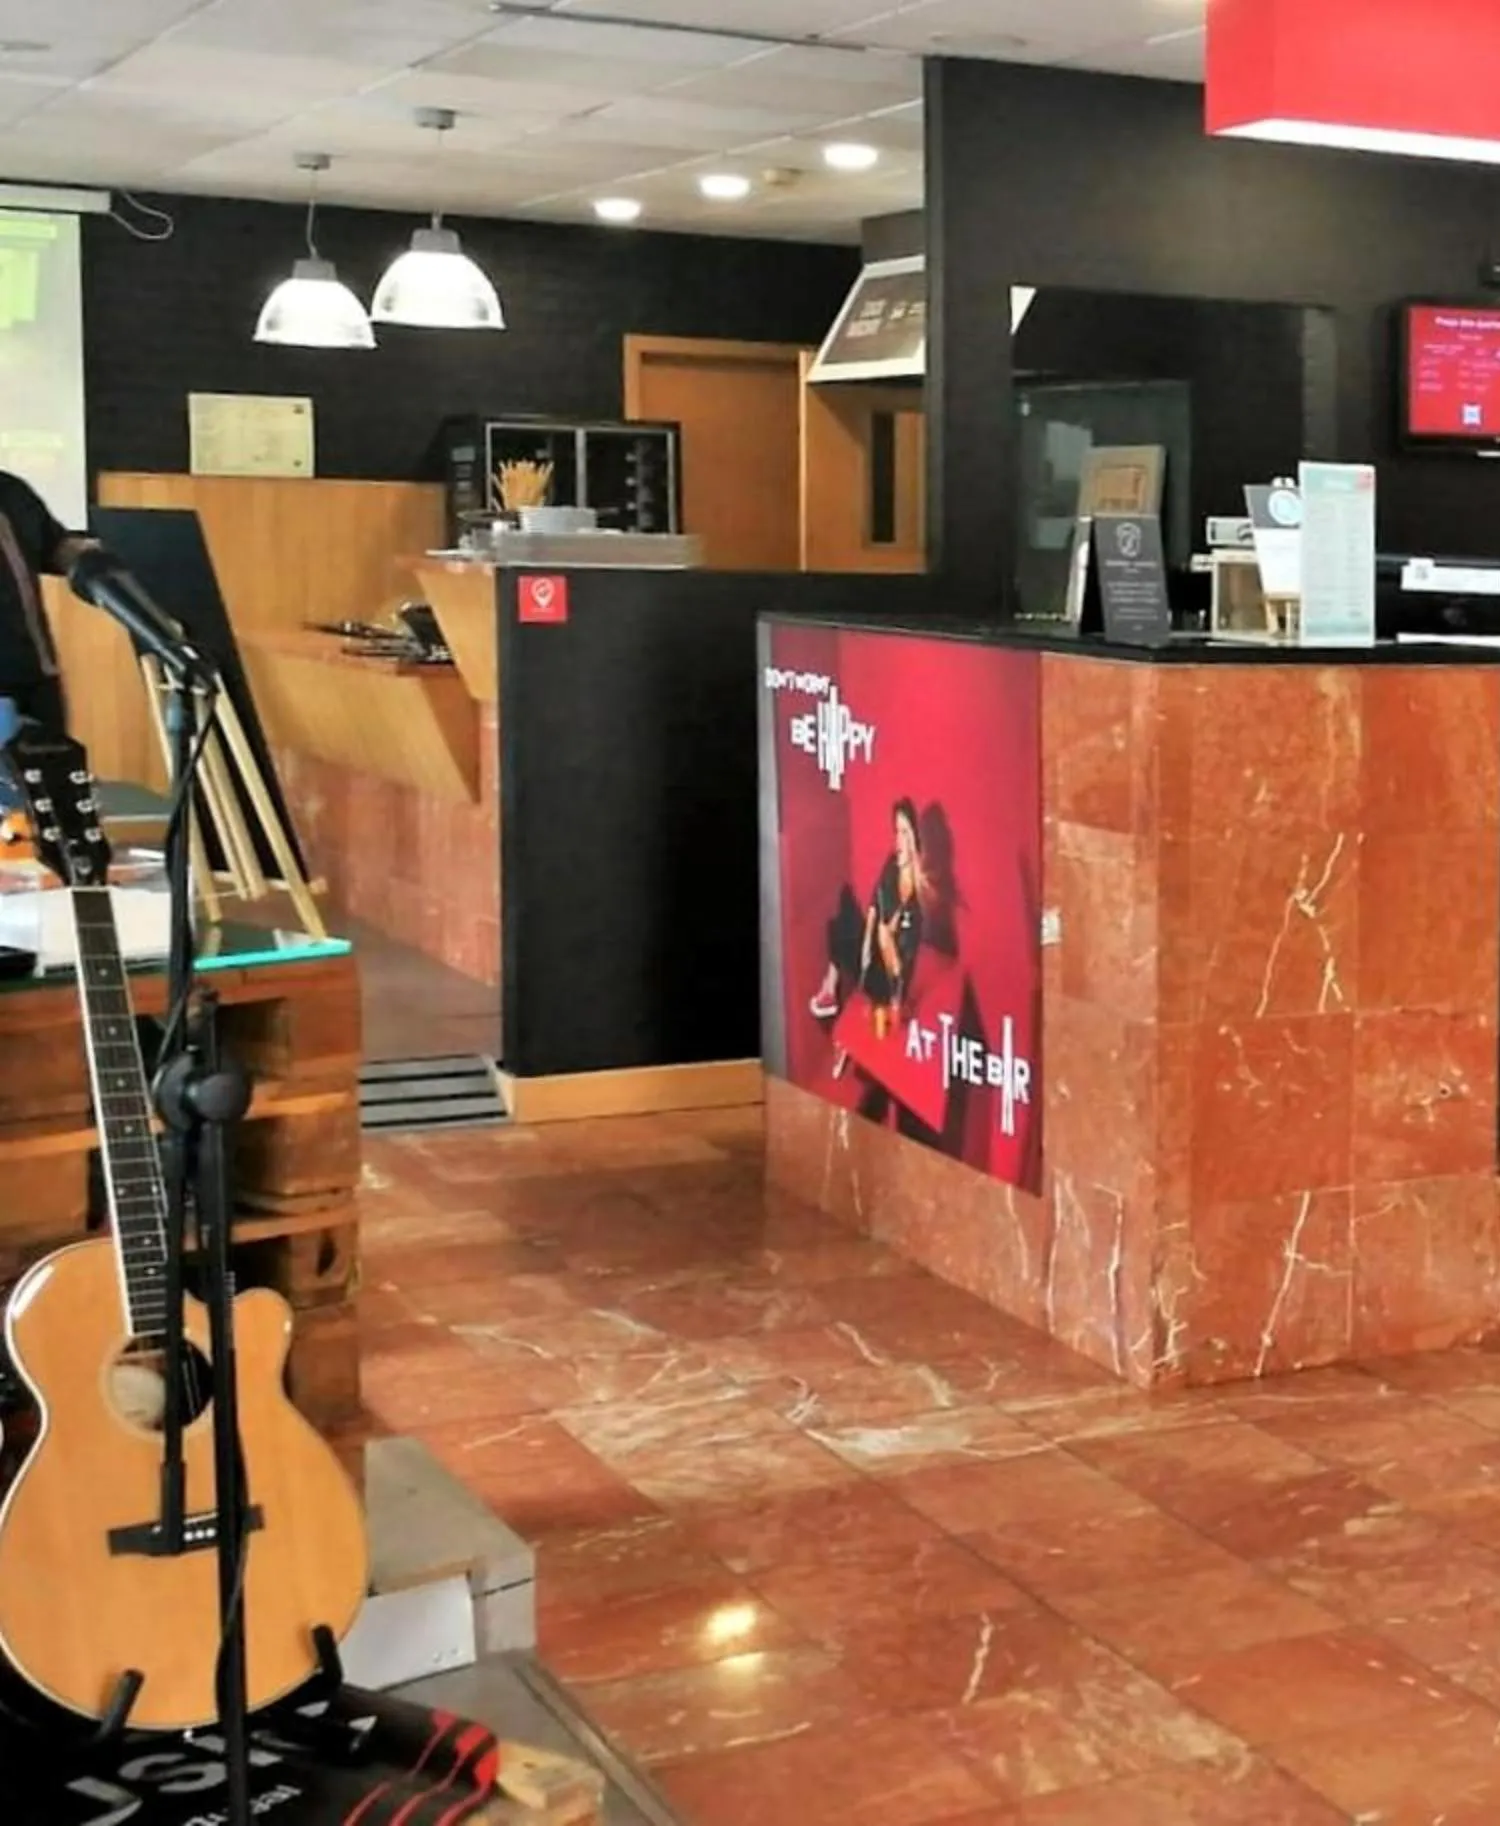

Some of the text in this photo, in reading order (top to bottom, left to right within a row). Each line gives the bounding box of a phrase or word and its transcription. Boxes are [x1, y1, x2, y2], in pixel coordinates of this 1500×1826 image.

[791, 714, 817, 753] BE
[905, 1019, 938, 1063] AT
[937, 1011, 984, 1090] THE
